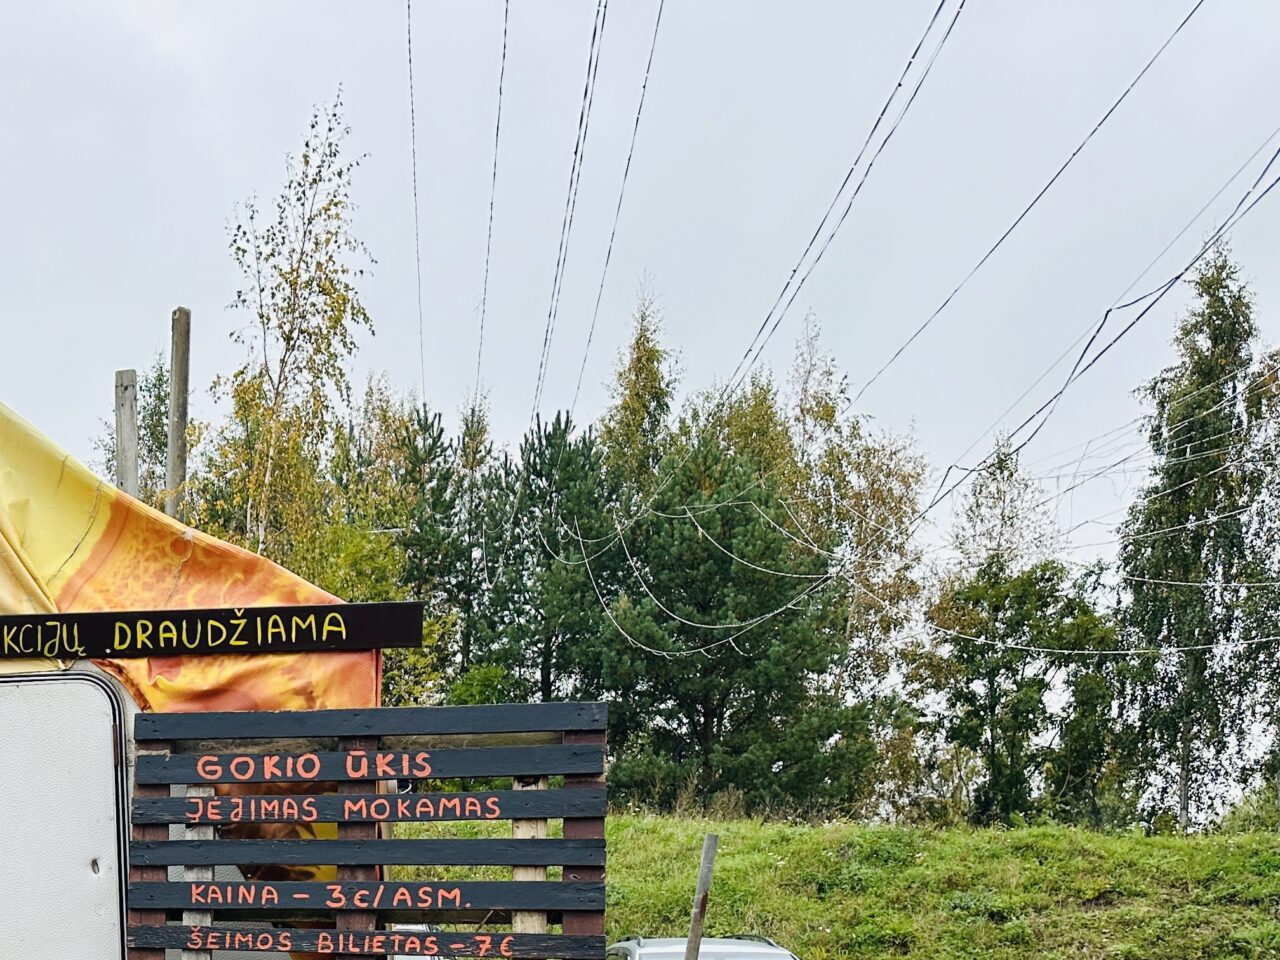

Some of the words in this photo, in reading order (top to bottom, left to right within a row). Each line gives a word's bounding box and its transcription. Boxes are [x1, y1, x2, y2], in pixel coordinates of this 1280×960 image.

[113, 608, 347, 650] DRAUDŽIAMA
[196, 753, 321, 780] GOKIO
[345, 750, 433, 779] ŪKIS
[344, 796, 502, 820] MOKAMAS
[191, 883, 279, 906] KAINA
[187, 926, 292, 951] ŠEIMOS
[316, 933, 439, 956] BILIETAS
